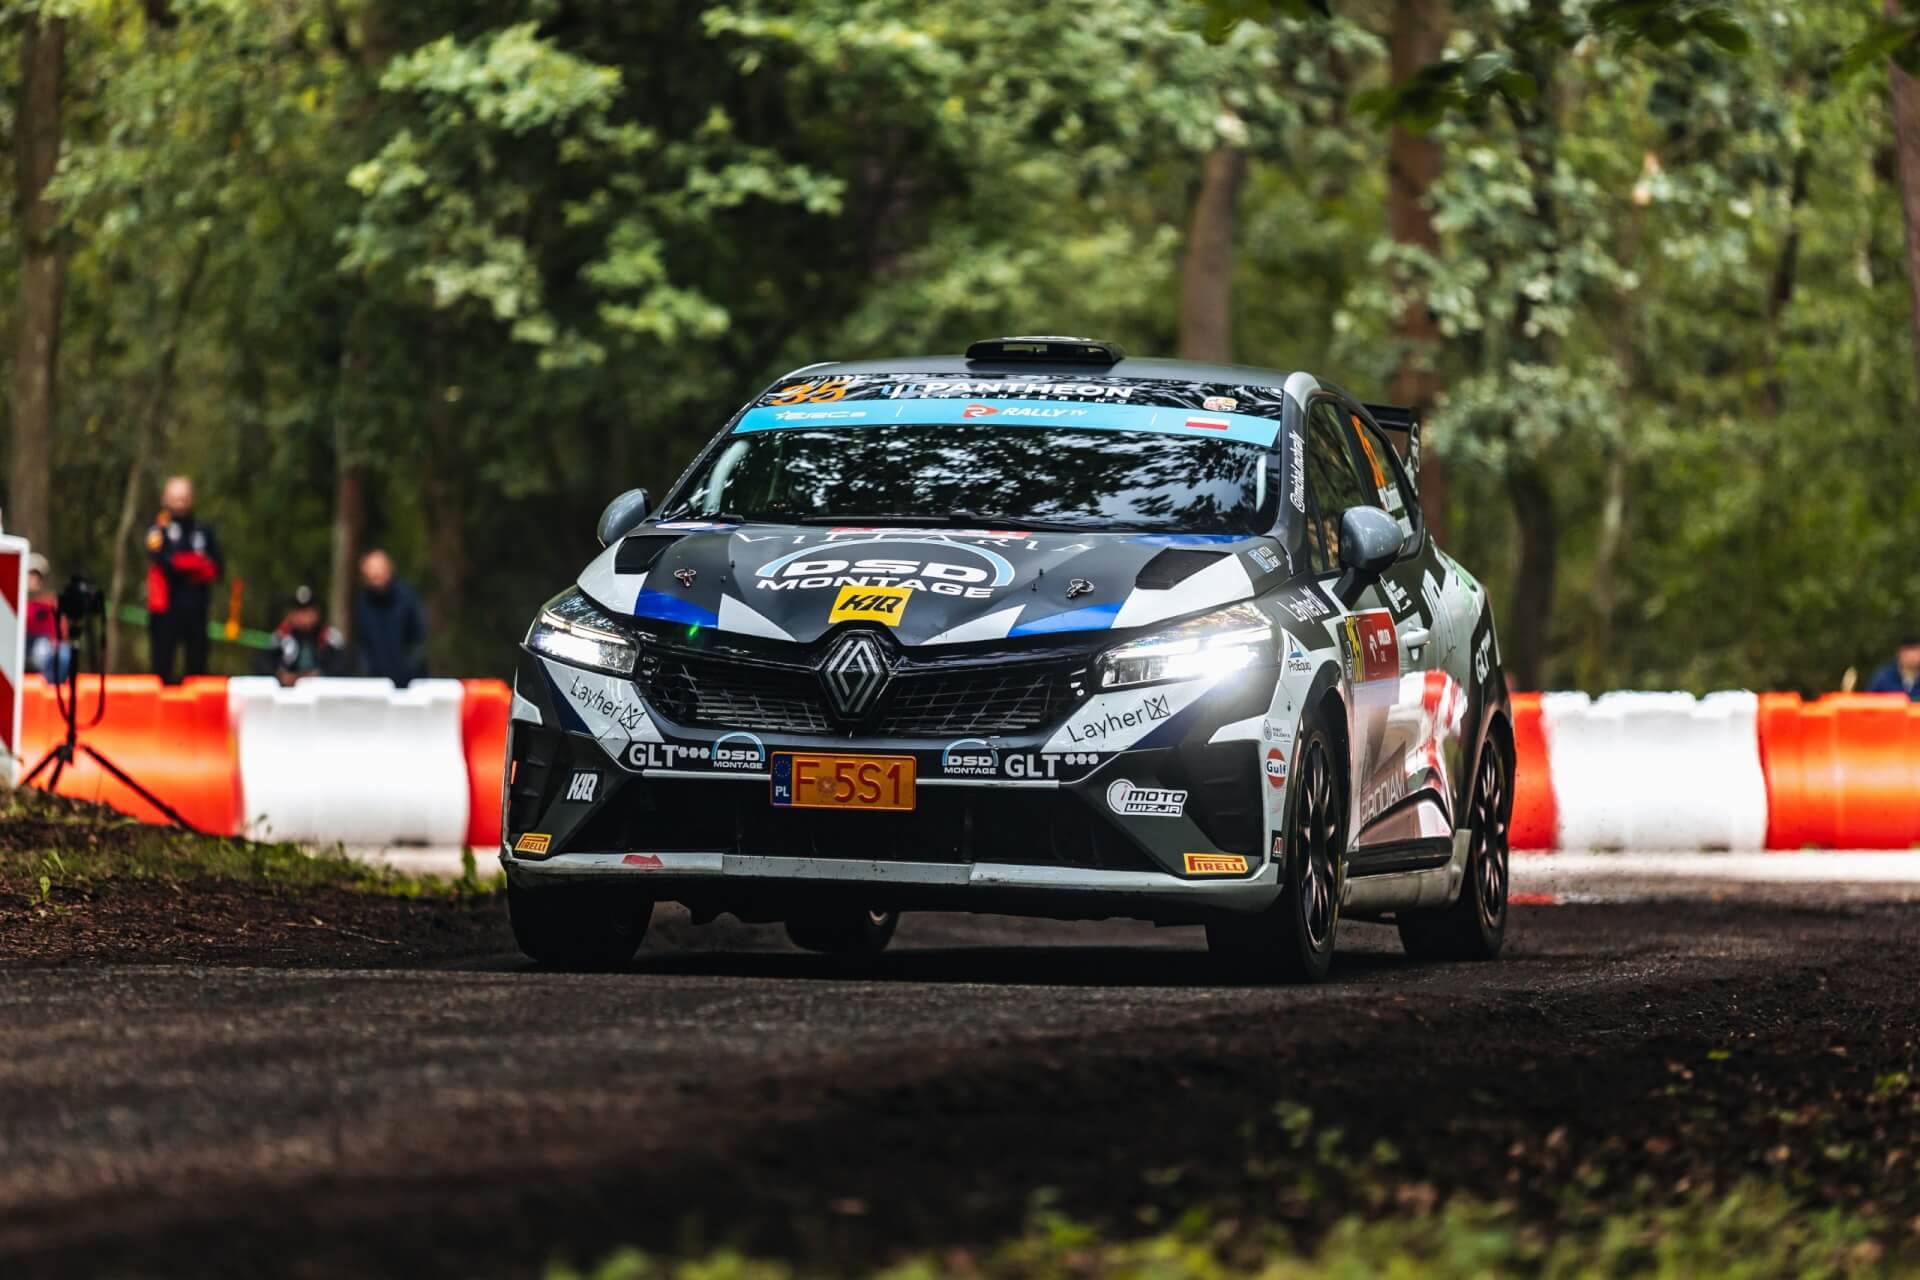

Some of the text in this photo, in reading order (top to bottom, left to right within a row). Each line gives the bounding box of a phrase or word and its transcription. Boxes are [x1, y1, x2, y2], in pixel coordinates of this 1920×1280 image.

[924, 382, 1134, 397] PANTHEON
[918, 393, 1128, 404] ENGINEERING
[1001, 407, 1068, 417] RALLY
[782, 559, 988, 582] DSD
[756, 576, 995, 598] MONTAGE
[570, 675, 623, 719] Layher
[1066, 708, 1143, 742] Layher
[629, 744, 679, 767] GLT
[716, 749, 760, 761] DSD
[947, 756, 993, 767] DSD
[713, 760, 763, 769] MONTAGE
[944, 766, 996, 775] MONTAGE
[1005, 754, 1061, 777] GLT
[1266, 761, 1286, 776] Gulf
[834, 761, 901, 804] 5S1
[775, 785, 790, 797] PL
[1128, 790, 1186, 803] MOTO
[1125, 803, 1181, 814] WIZJA
[517, 836, 549, 851] PIRELLI
[1187, 855, 1246, 872] PIRELLI
